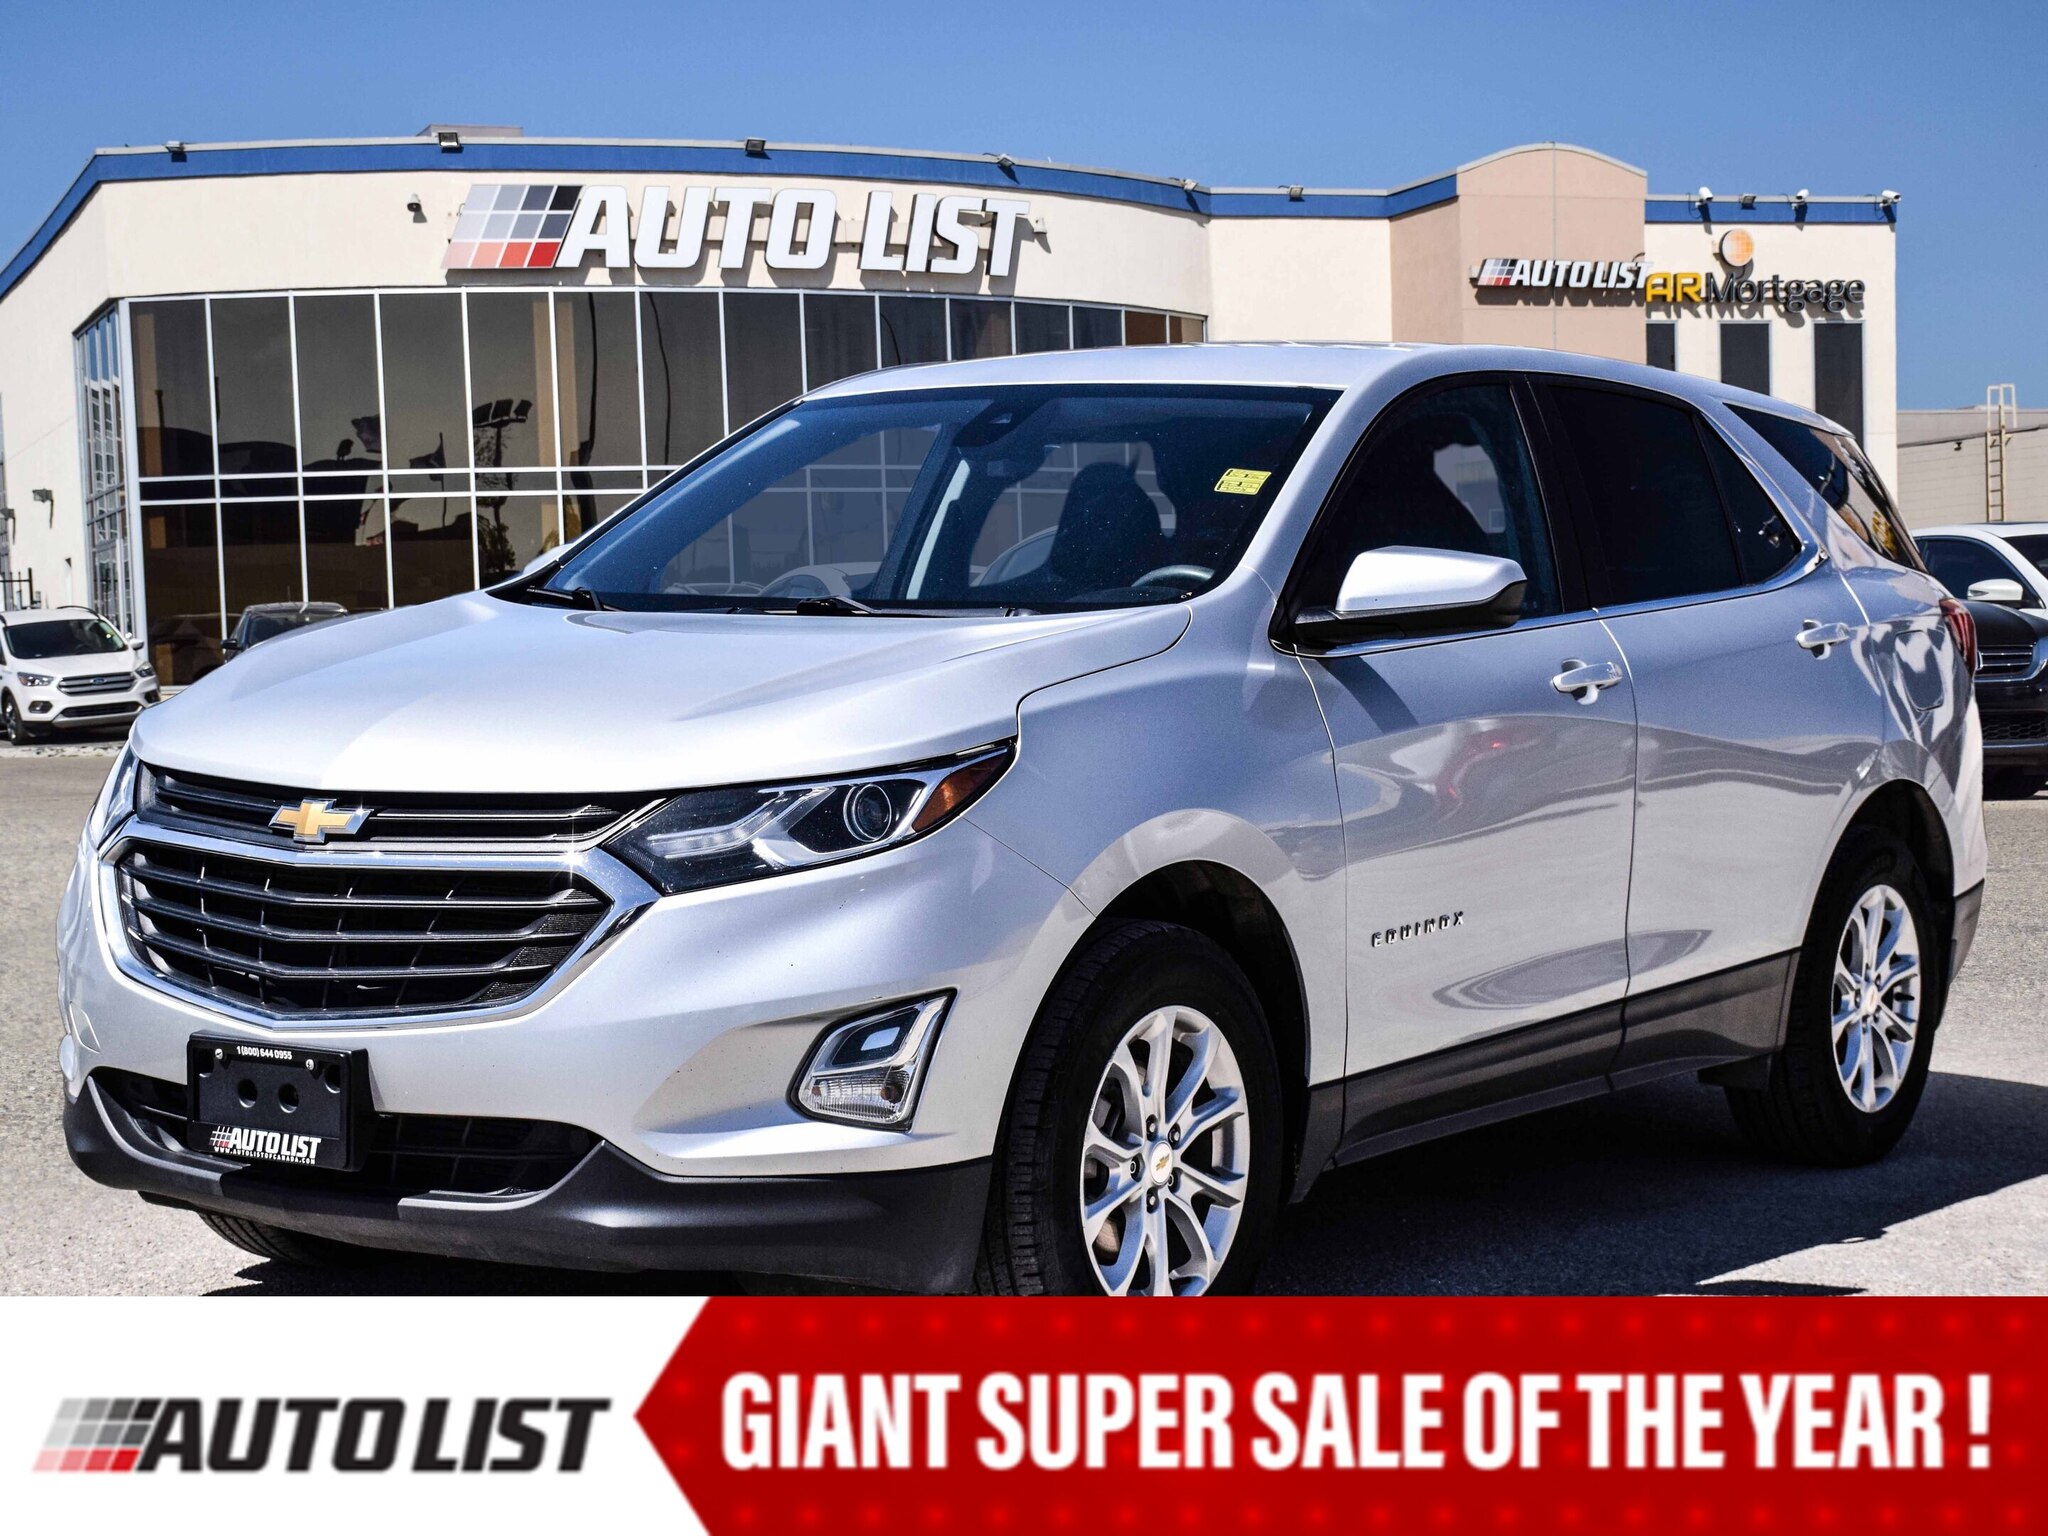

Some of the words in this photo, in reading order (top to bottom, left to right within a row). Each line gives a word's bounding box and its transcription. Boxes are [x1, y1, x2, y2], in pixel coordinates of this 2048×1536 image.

[555, 184, 838, 270] AUTO
[860, 190, 1031, 277] LIST
[1510, 259, 1591, 289] AUTO
[1592, 261, 1654, 290] LIST
[1645, 271, 1702, 303] AR
[1705, 271, 1866, 314] Mortgage
[1371, 910, 1465, 948] EQUINOX
[241, 1045, 260, 1058] (800)
[228, 1127, 282, 1153] AUTO
[281, 1133, 322, 1159] LIST
